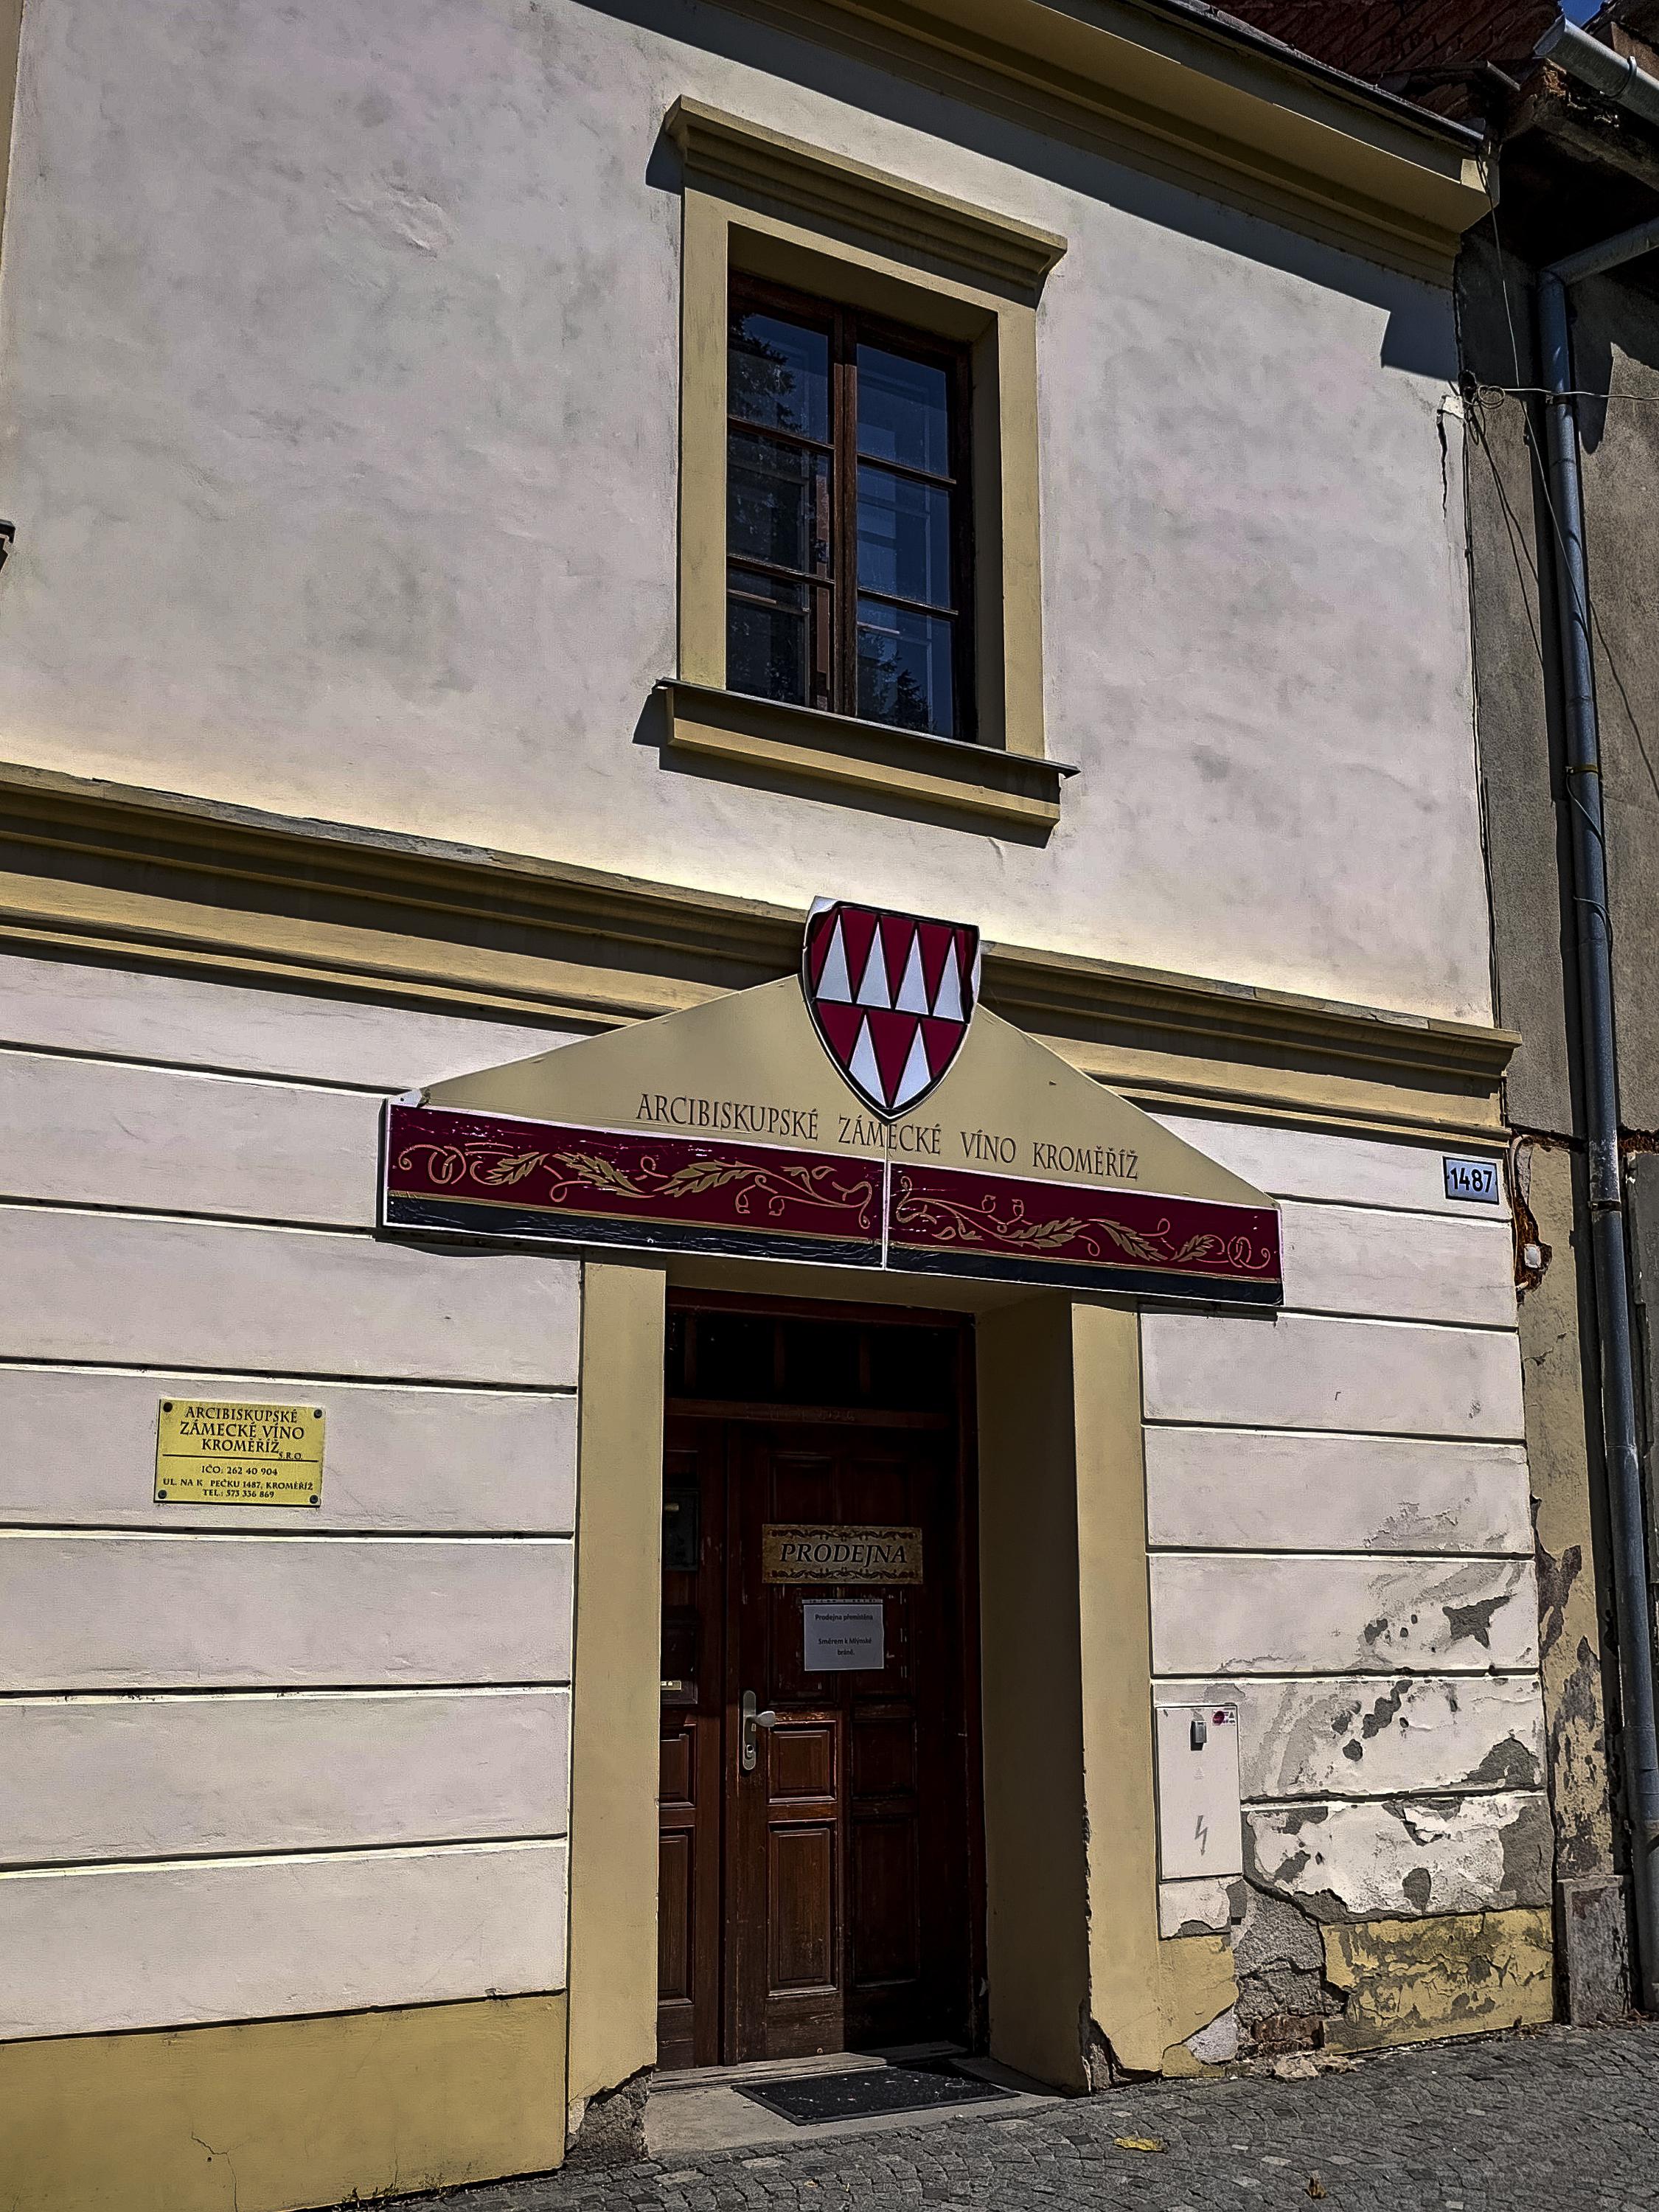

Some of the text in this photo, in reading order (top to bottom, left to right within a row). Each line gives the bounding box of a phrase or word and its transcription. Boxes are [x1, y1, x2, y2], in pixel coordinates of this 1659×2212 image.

[636, 1093, 1138, 1180] ARCIBISKUPSKÉ ZÁMECKÉ VÍNO KROMĚŘÍŽ
[1450, 1168, 1492, 1192] 1487
[185, 1406, 297, 1423] ARCIBISKUPSKÉ
[180, 1420, 304, 1439] ZÁMECKÉ VÍNO
[202, 1438, 279, 1453] KROMĚŘÍŽ
[226, 1466, 243, 1475] 262
[246, 1467, 258, 1475] 40
[260, 1467, 278, 1476] 904
[180, 1478, 194, 1486] NA
[210, 1478, 240, 1488] PEČKU
[265, 1481, 313, 1490] KROMĚŘÍŽ
[226, 1489, 240, 1498] 573
[780, 1543, 907, 1568] PRODEJNA
[815, 1613, 842, 1621] Prodejna
